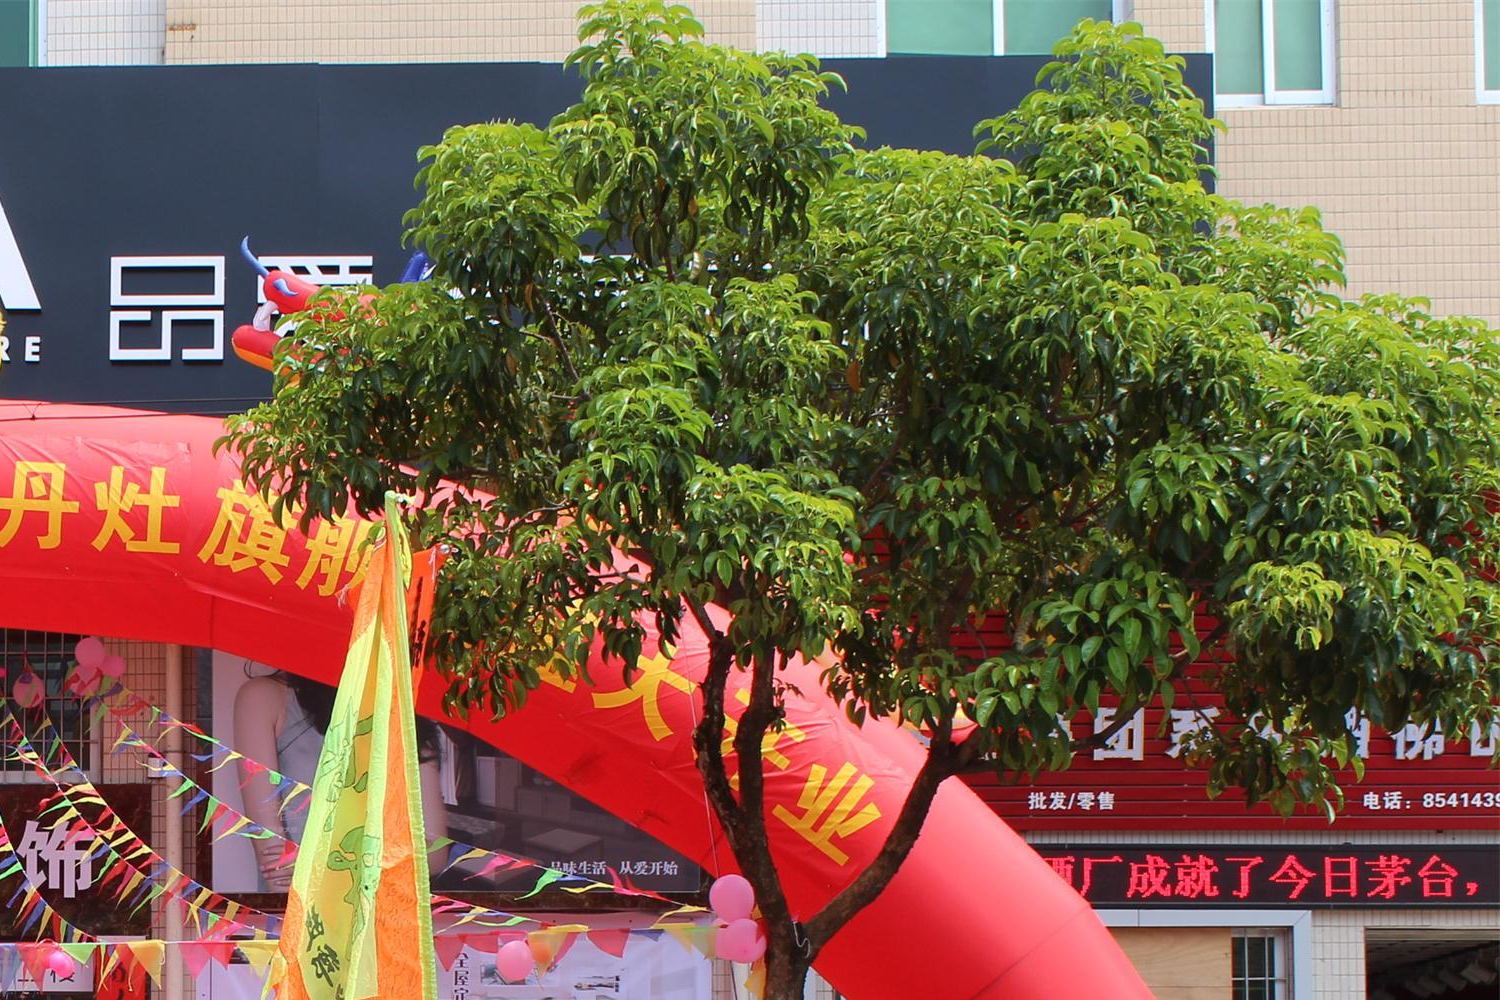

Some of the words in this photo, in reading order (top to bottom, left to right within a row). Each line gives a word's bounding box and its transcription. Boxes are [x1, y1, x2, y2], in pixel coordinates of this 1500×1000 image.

[1028, 791, 1116, 811] 批发/零售
[619, 860, 678, 876] 从爱开始
